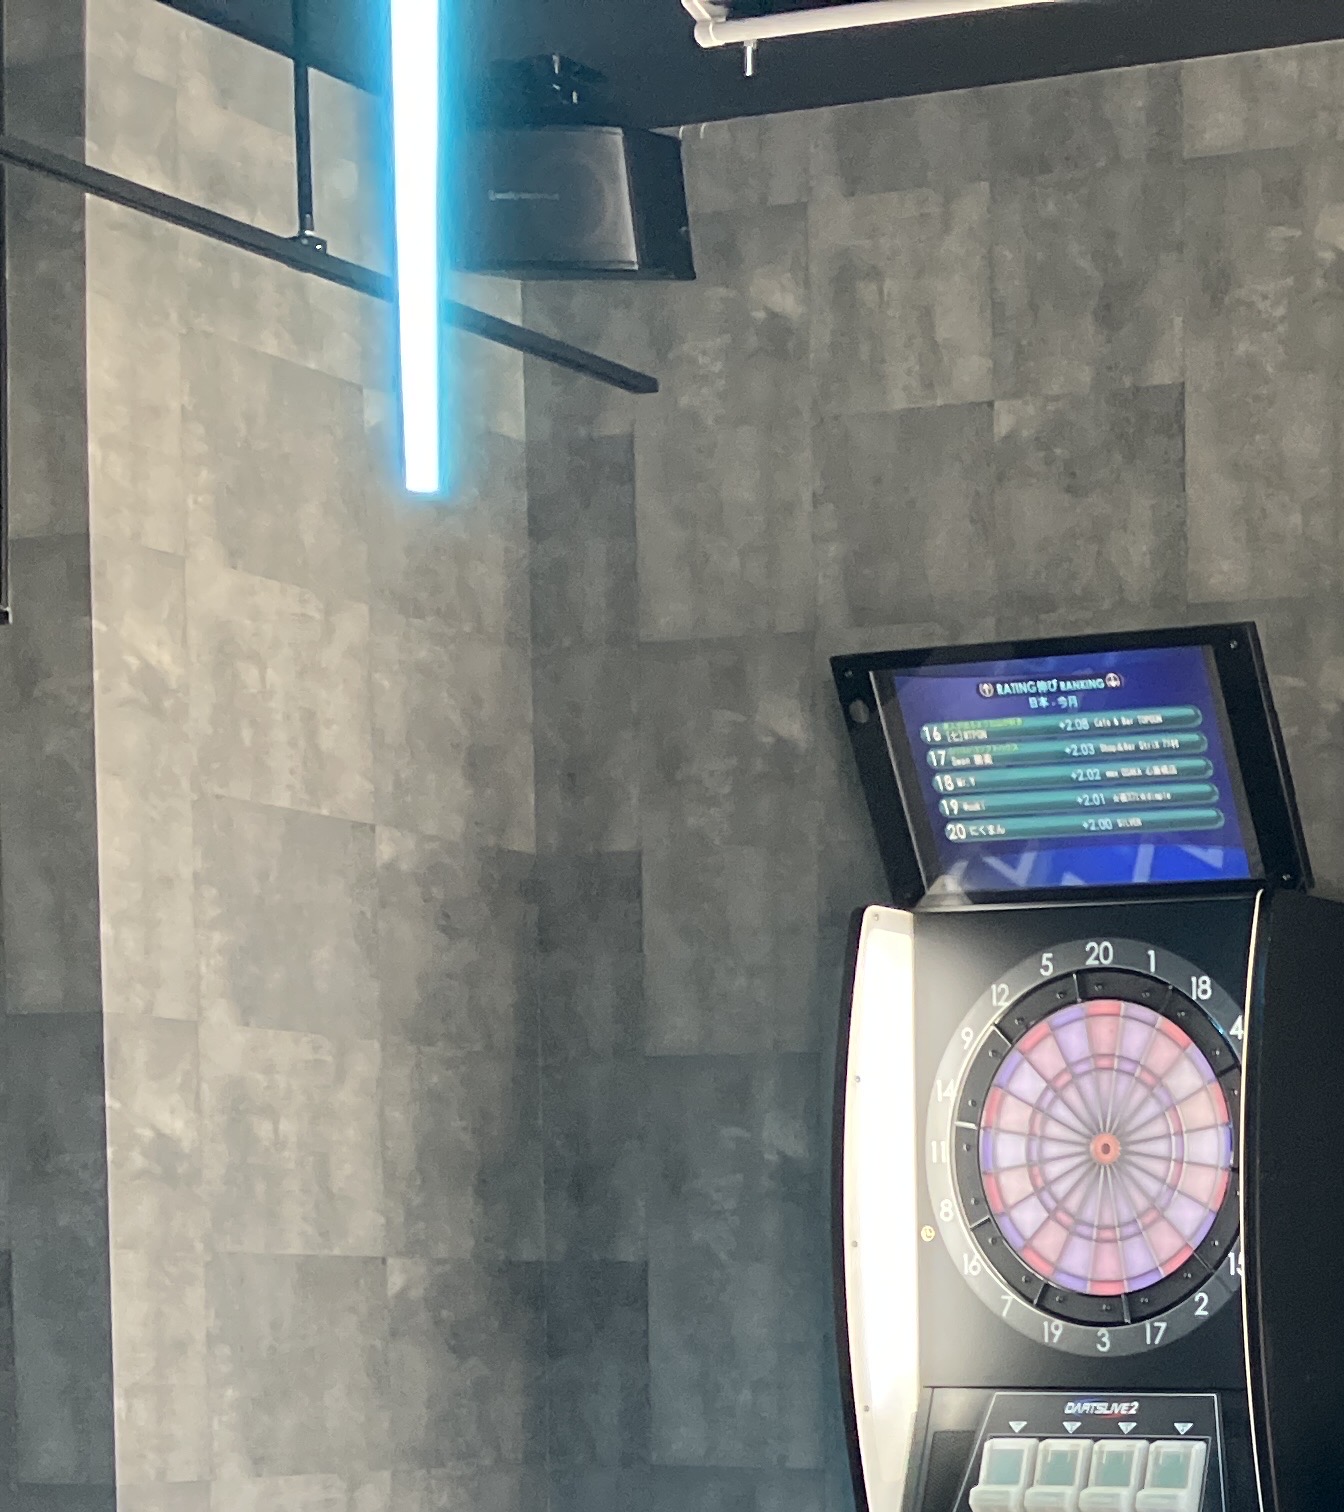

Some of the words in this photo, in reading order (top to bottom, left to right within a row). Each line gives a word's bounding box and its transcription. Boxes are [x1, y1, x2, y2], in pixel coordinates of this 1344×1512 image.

[1060, 678, 1105, 692] RANKING
[922, 726, 942, 743] 16
[929, 749, 946, 767] 17
[934, 774, 955, 792] 18
[941, 798, 959, 817] 19
[946, 821, 967, 840] 20
[1040, 953, 1054, 976] 5
[1085, 942, 1113, 966] 20
[1147, 950, 1155, 973] 1
[991, 984, 1009, 1008] 12
[1191, 976, 1211, 1000] 18
[961, 1028, 973, 1050] 9
[931, 1141, 947, 1162] 11
[939, 1199, 954, 1221] 8
[963, 1253, 981, 1276] 16
[1001, 1295, 1013, 1317] 7
[1194, 1294, 1209, 1316] 2
[1043, 1321, 1063, 1343] 19
[1096, 1329, 1111, 1351] 3
[1145, 1322, 1167, 1344] 17
